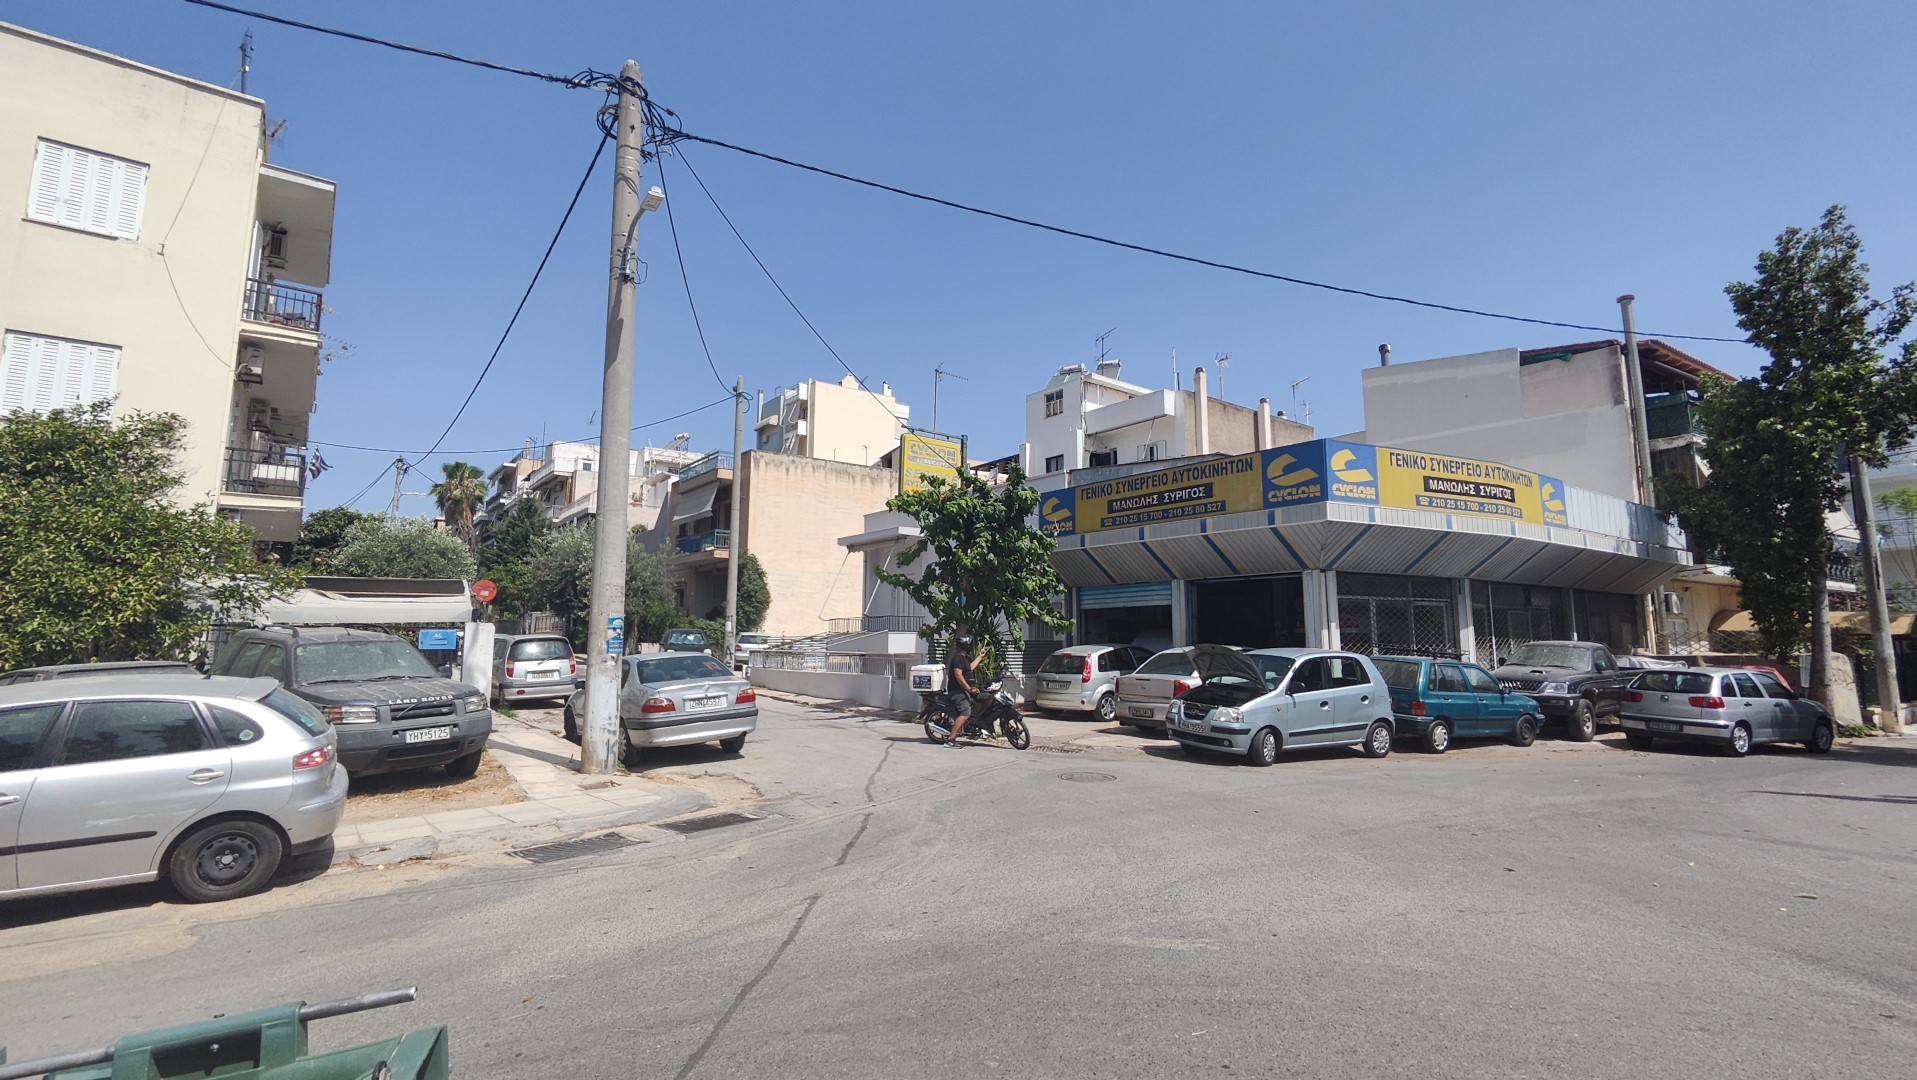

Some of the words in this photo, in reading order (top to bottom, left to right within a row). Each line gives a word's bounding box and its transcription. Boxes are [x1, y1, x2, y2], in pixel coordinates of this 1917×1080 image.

[1081, 483, 1113, 500] ΓΕΝΙΚΟ
[1115, 473, 1168, 494] ΣΥΝΕΡΓΕΙΟ
[1171, 457, 1253, 484] ΑΥΤΟΚΙΝΗΤΩΝ
[1389, 452, 1427, 471] ΓΕΝΙΚΟ
[1429, 457, 1482, 477] ΣΥΝΕΡΓΕΙΟ
[1485, 465, 1533, 488] ΑΥΤΟΚΙΝΗΤΩΝ
[1112, 494, 1159, 511] ΜΑΝΩΛΗΣ
[1163, 486, 1206, 503] ΣΥΡΙΓΟΣ
[1267, 484, 1321, 503] CYCLON
[1331, 483, 1377, 500] CYCLON
[1429, 479, 1476, 495] ΜΑΝΩΛΗΣ
[1479, 483, 1513, 500] ΣΥΡΙΓΟΣ
[1115, 516, 1128, 525] 210
[1129, 514, 1138, 523] 25
[1139, 513, 1148, 522] 15
[1149, 511, 1163, 520] 700
[1168, 508, 1182, 517] 210
[1183, 506, 1193, 515] 25
[1195, 504, 1205, 513] 80
[1206, 502, 1222, 512] 527
[1432, 498, 1446, 507] 210
[1446, 499, 1456, 508] 25
[1457, 500, 1466, 509] 15
[1466, 502, 1479, 511] 700
[1484, 504, 1497, 512] 210
[1497, 505, 1506, 514] 25
